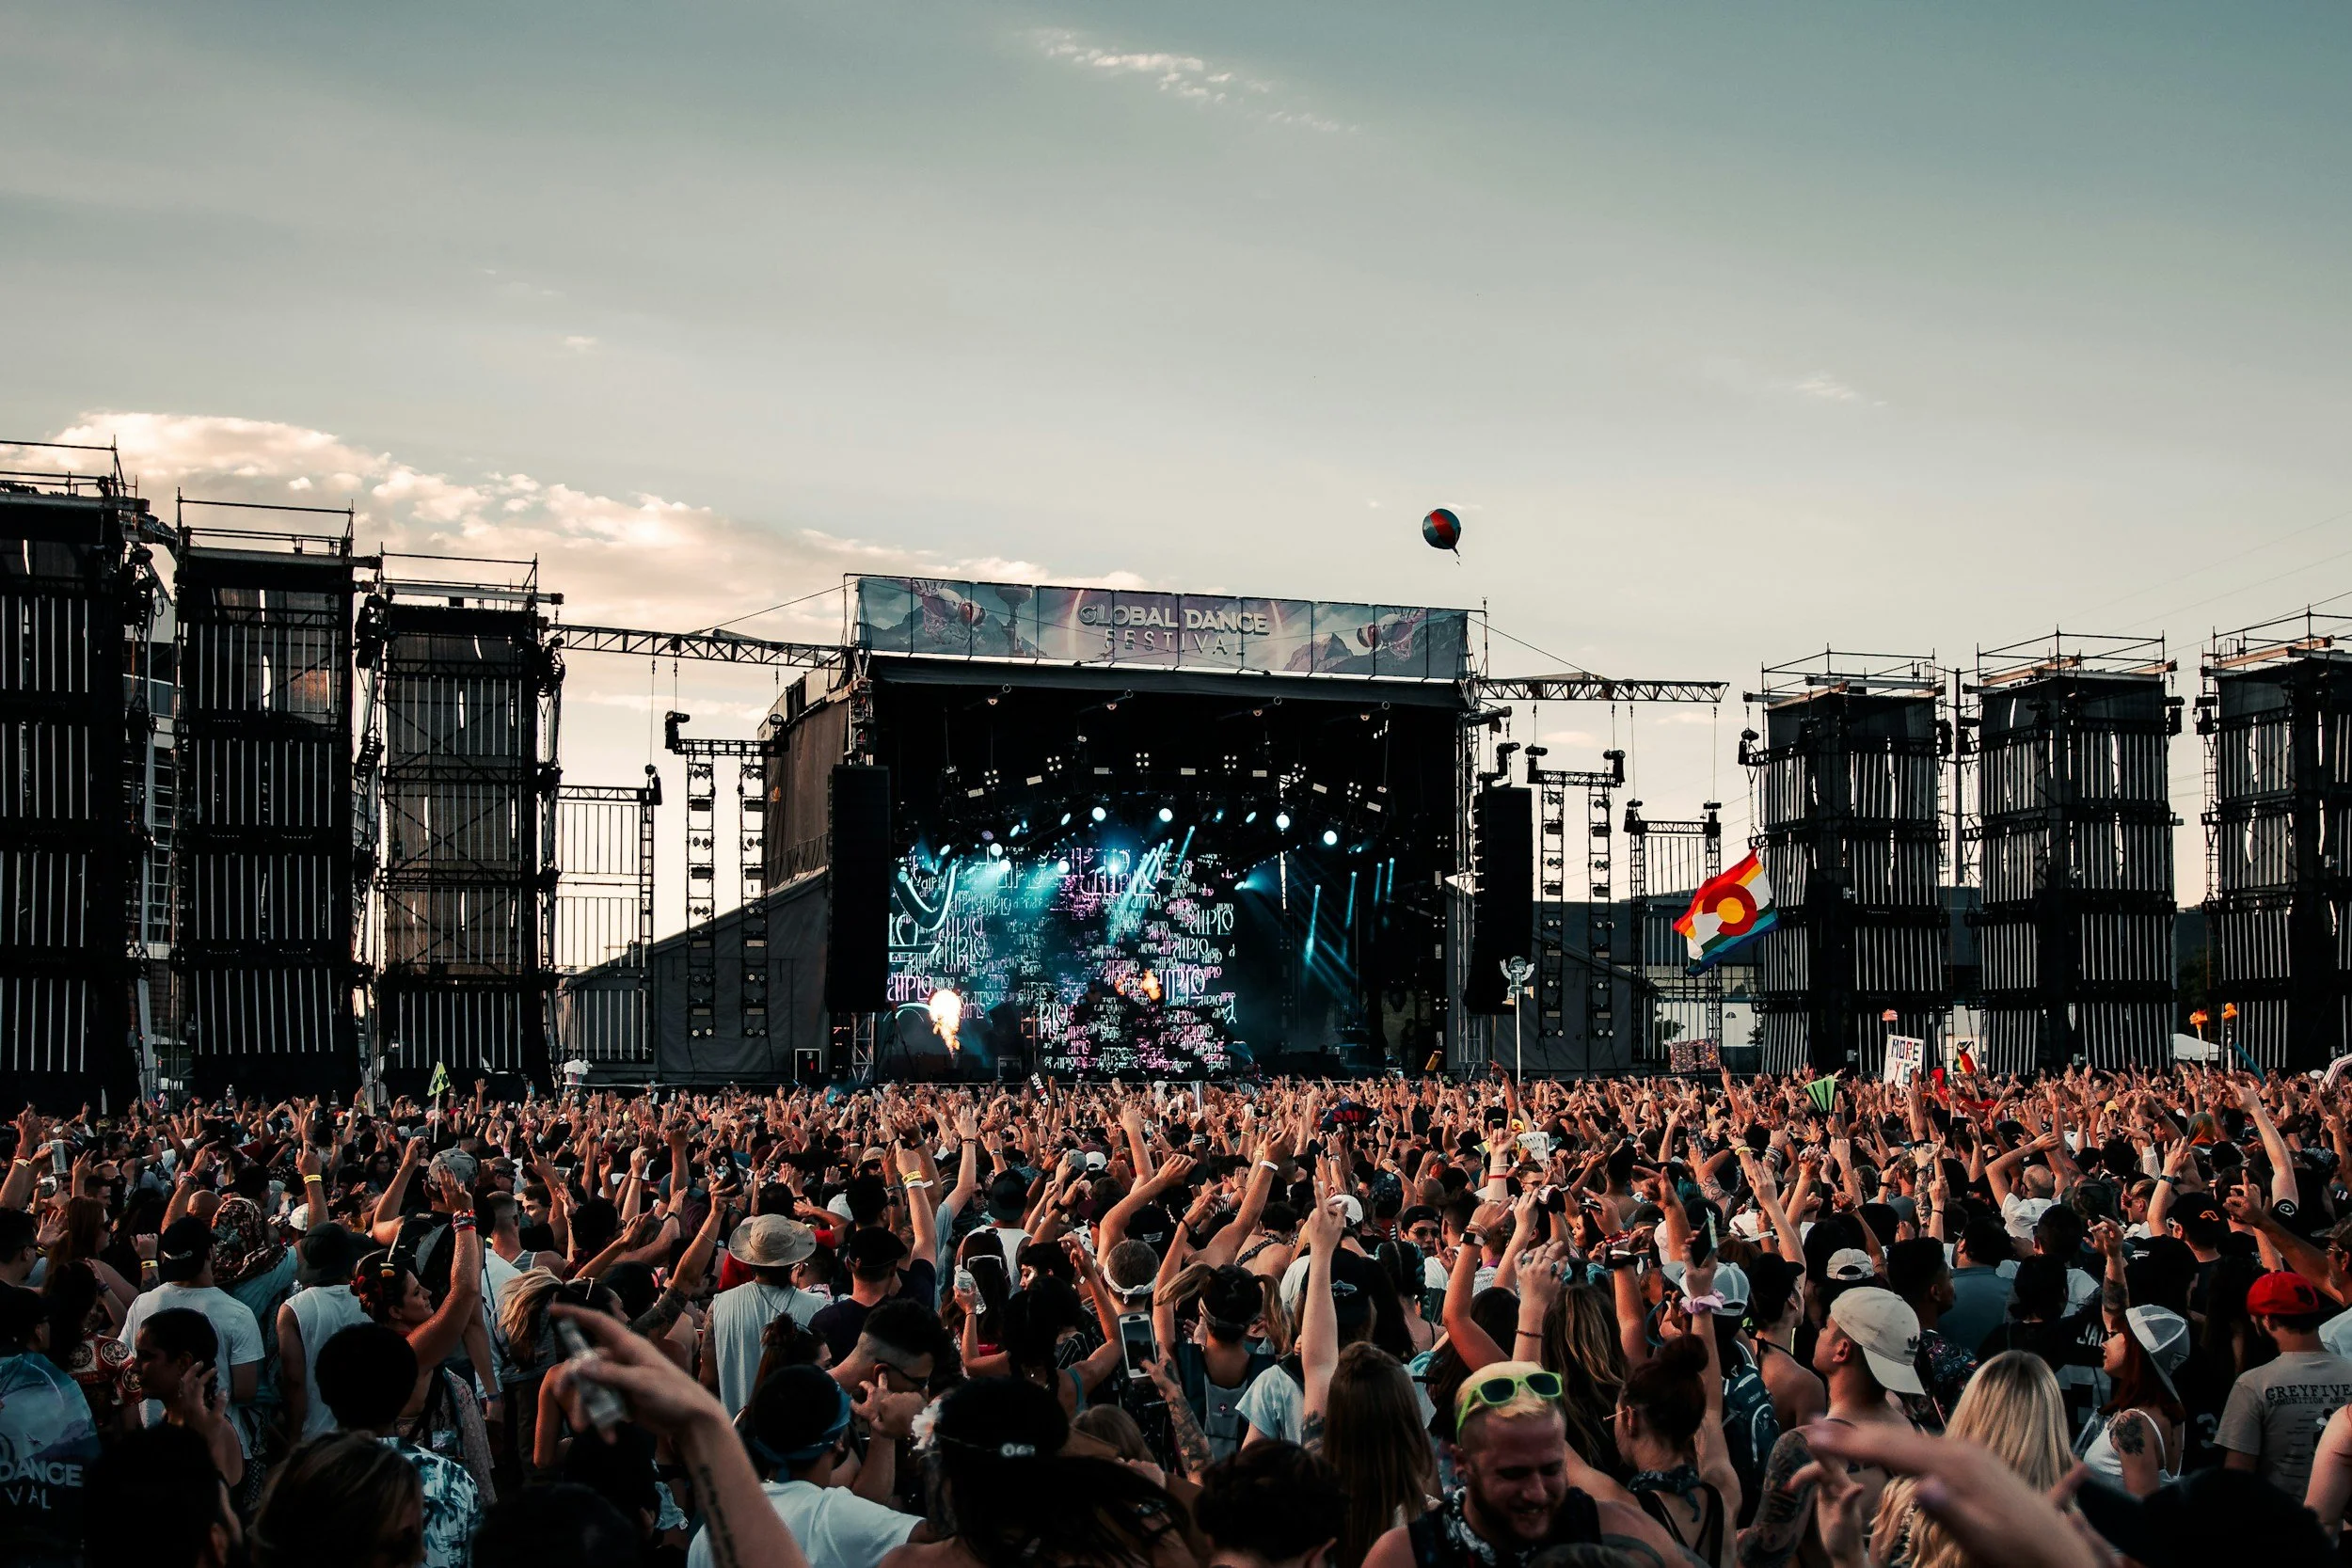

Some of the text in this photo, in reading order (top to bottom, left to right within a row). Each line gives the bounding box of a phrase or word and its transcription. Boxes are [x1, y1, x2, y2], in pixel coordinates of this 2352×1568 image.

[1079, 604, 1270, 636] GLOBAL DANCE
[1104, 628, 1245, 657] FESTIVAL
[1891, 1038, 1920, 1061] MORE
[1895, 1061, 1920, 1085] YE
[1030, 1072, 1051, 1106] SAVAGE
[0, 1458, 84, 1487] DANCE
